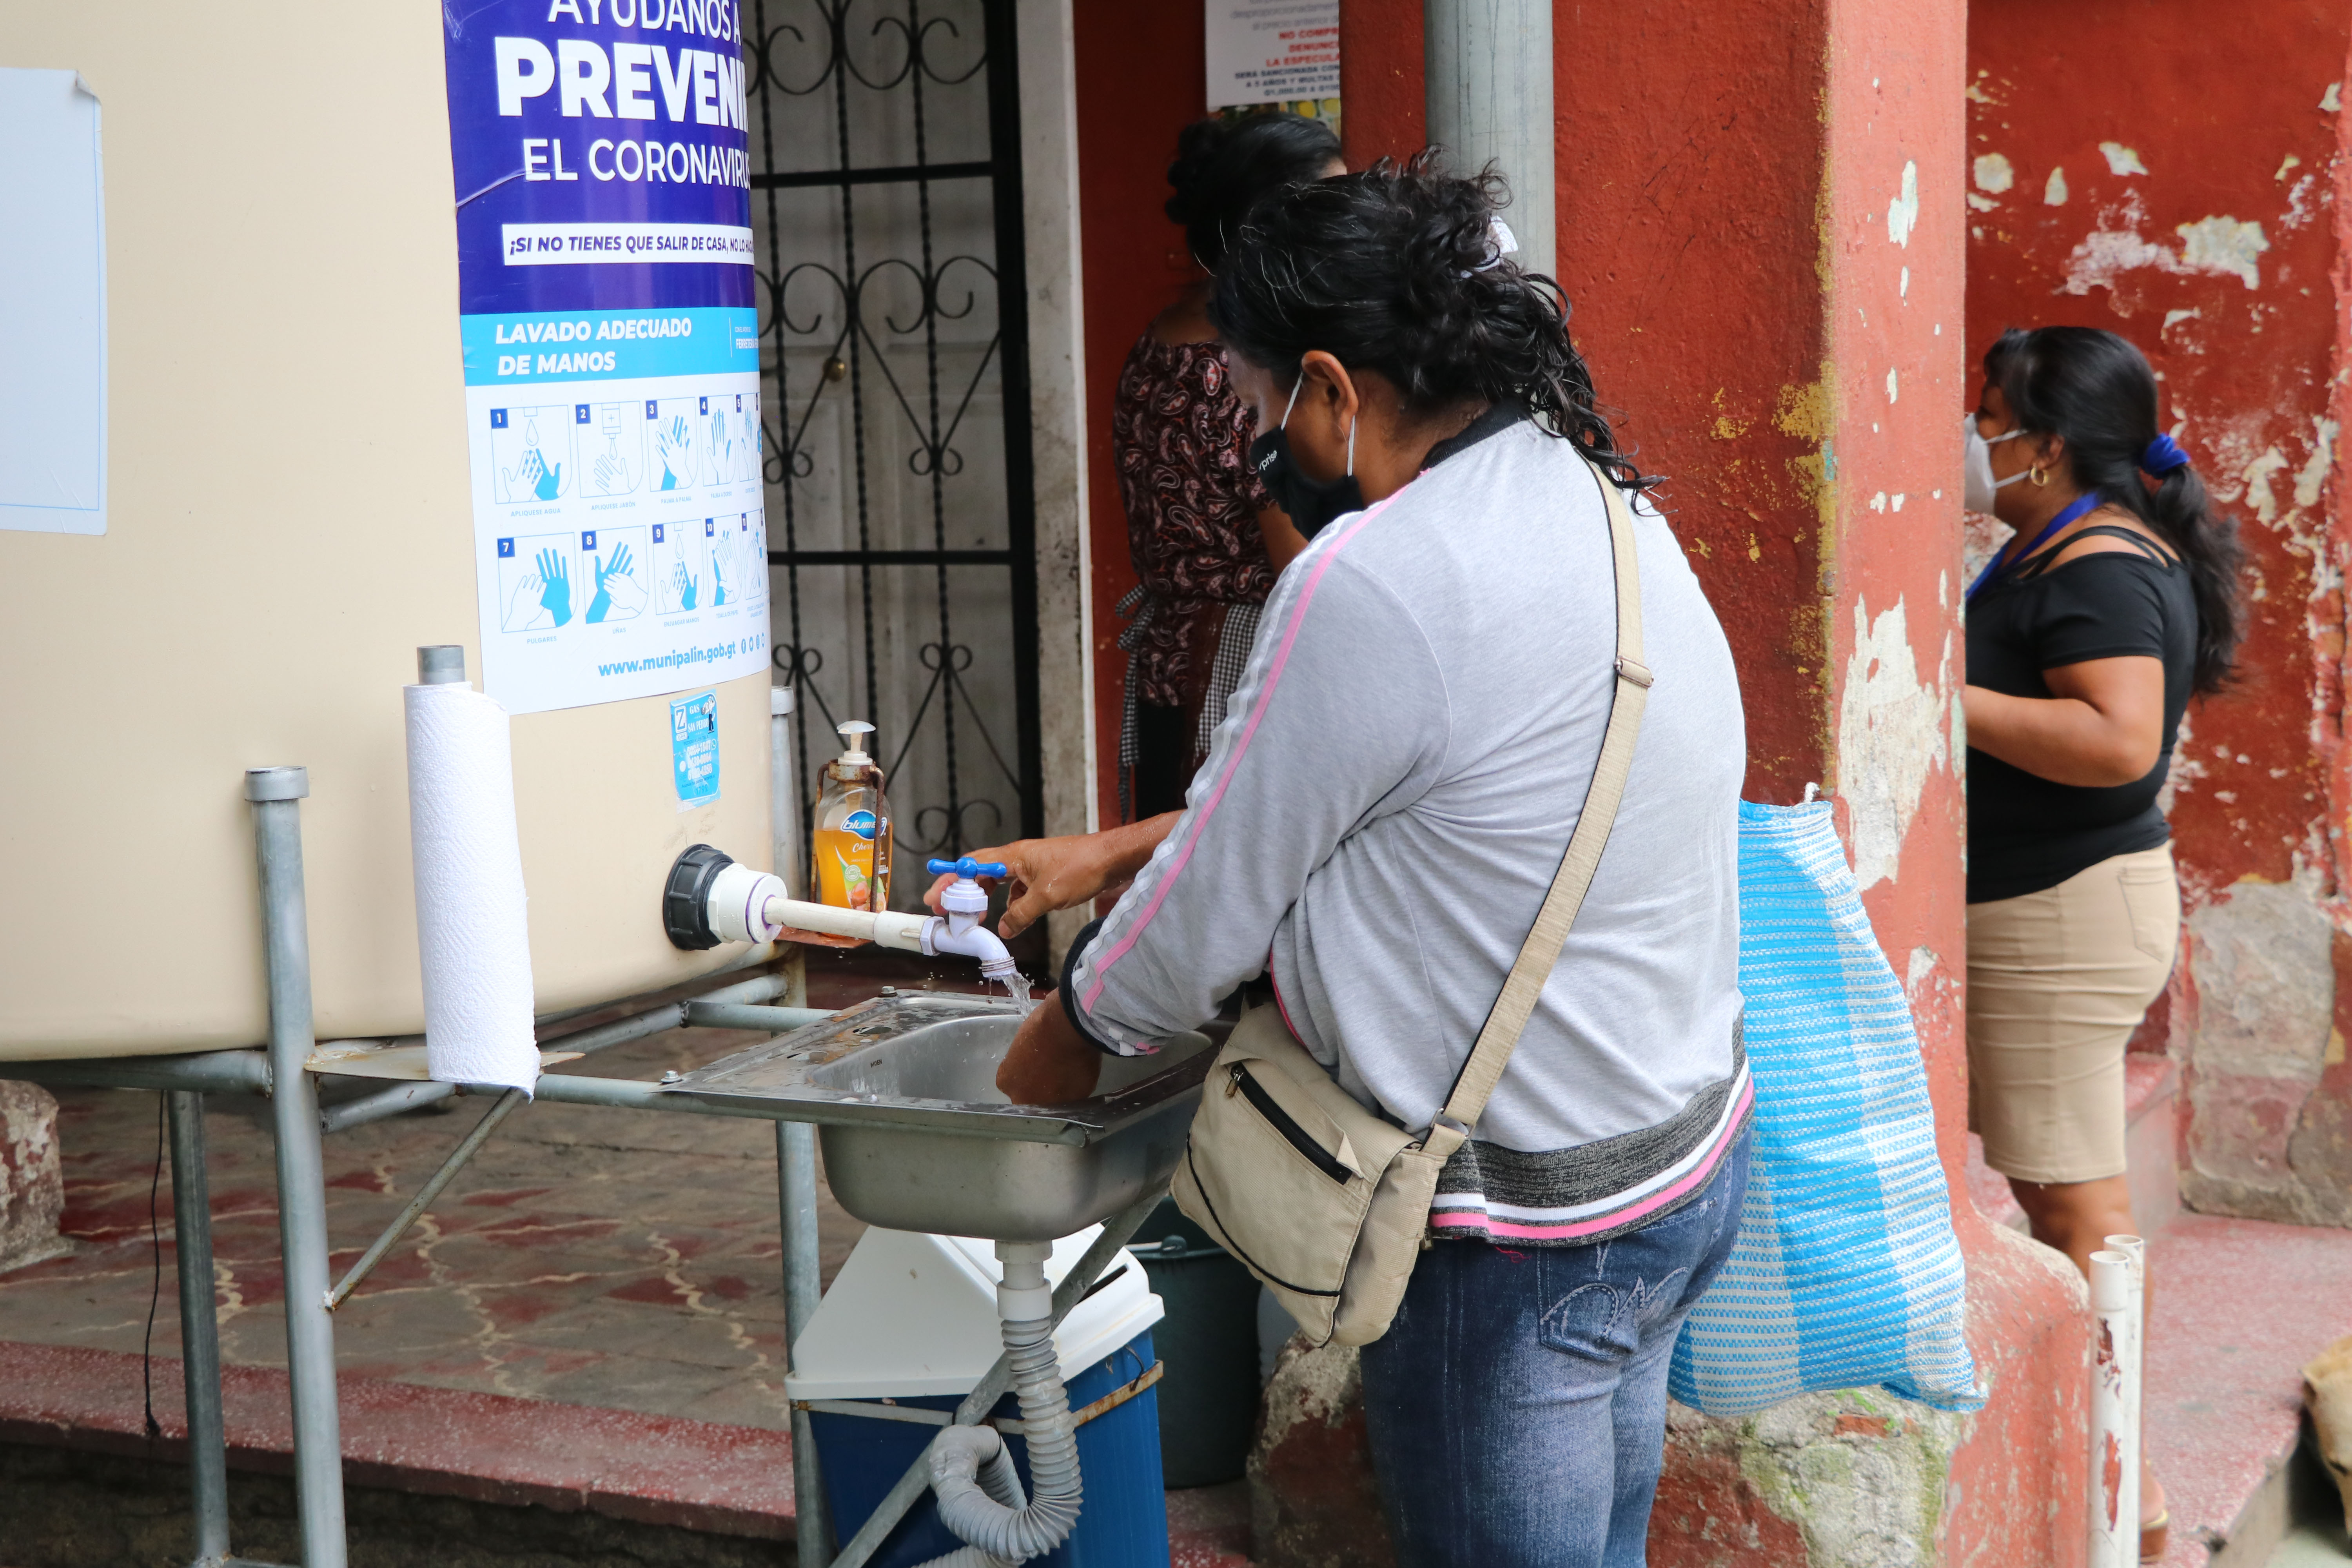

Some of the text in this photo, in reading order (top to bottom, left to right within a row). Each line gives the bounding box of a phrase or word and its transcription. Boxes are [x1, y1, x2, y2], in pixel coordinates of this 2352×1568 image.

[733, 2, 741, 46] A
[523, 139, 751, 191] EL CORONAVIRUS
[510, 237, 532, 255] ¡SI
[538, 237, 564, 252] NO
[569, 236, 622, 251] TIENES
[626, 236, 654, 254] QUE
[657, 236, 689, 251] SALIR
[691, 236, 704, 251] DE
[706, 236, 729, 254] CASA,
[730, 238, 739, 252] NO
[740, 238, 745, 252] LO
[495, 317, 692, 345] LAVADO ADECUADO
[497, 351, 616, 376] DE MANOS
[702, 401, 706, 410] 4
[737, 399, 740, 408] 5
[581, 409, 586, 419] 2
[650, 405, 655, 414] 3
[497, 413, 502, 424] 1
[742, 517, 746, 526] 11
[707, 523, 712, 532] 10
[656, 528, 661, 538] 9
[586, 535, 592, 545] 8
[503, 542, 510, 553] 7
[664, 619, 685, 627] ENJUAGAR
[527, 635, 557, 644] PULGARES
[598, 641, 736, 677] www.munipalin.gob.gt
[676, 704, 700, 730] Z GAS
[696, 718, 709, 730] PEDRO
